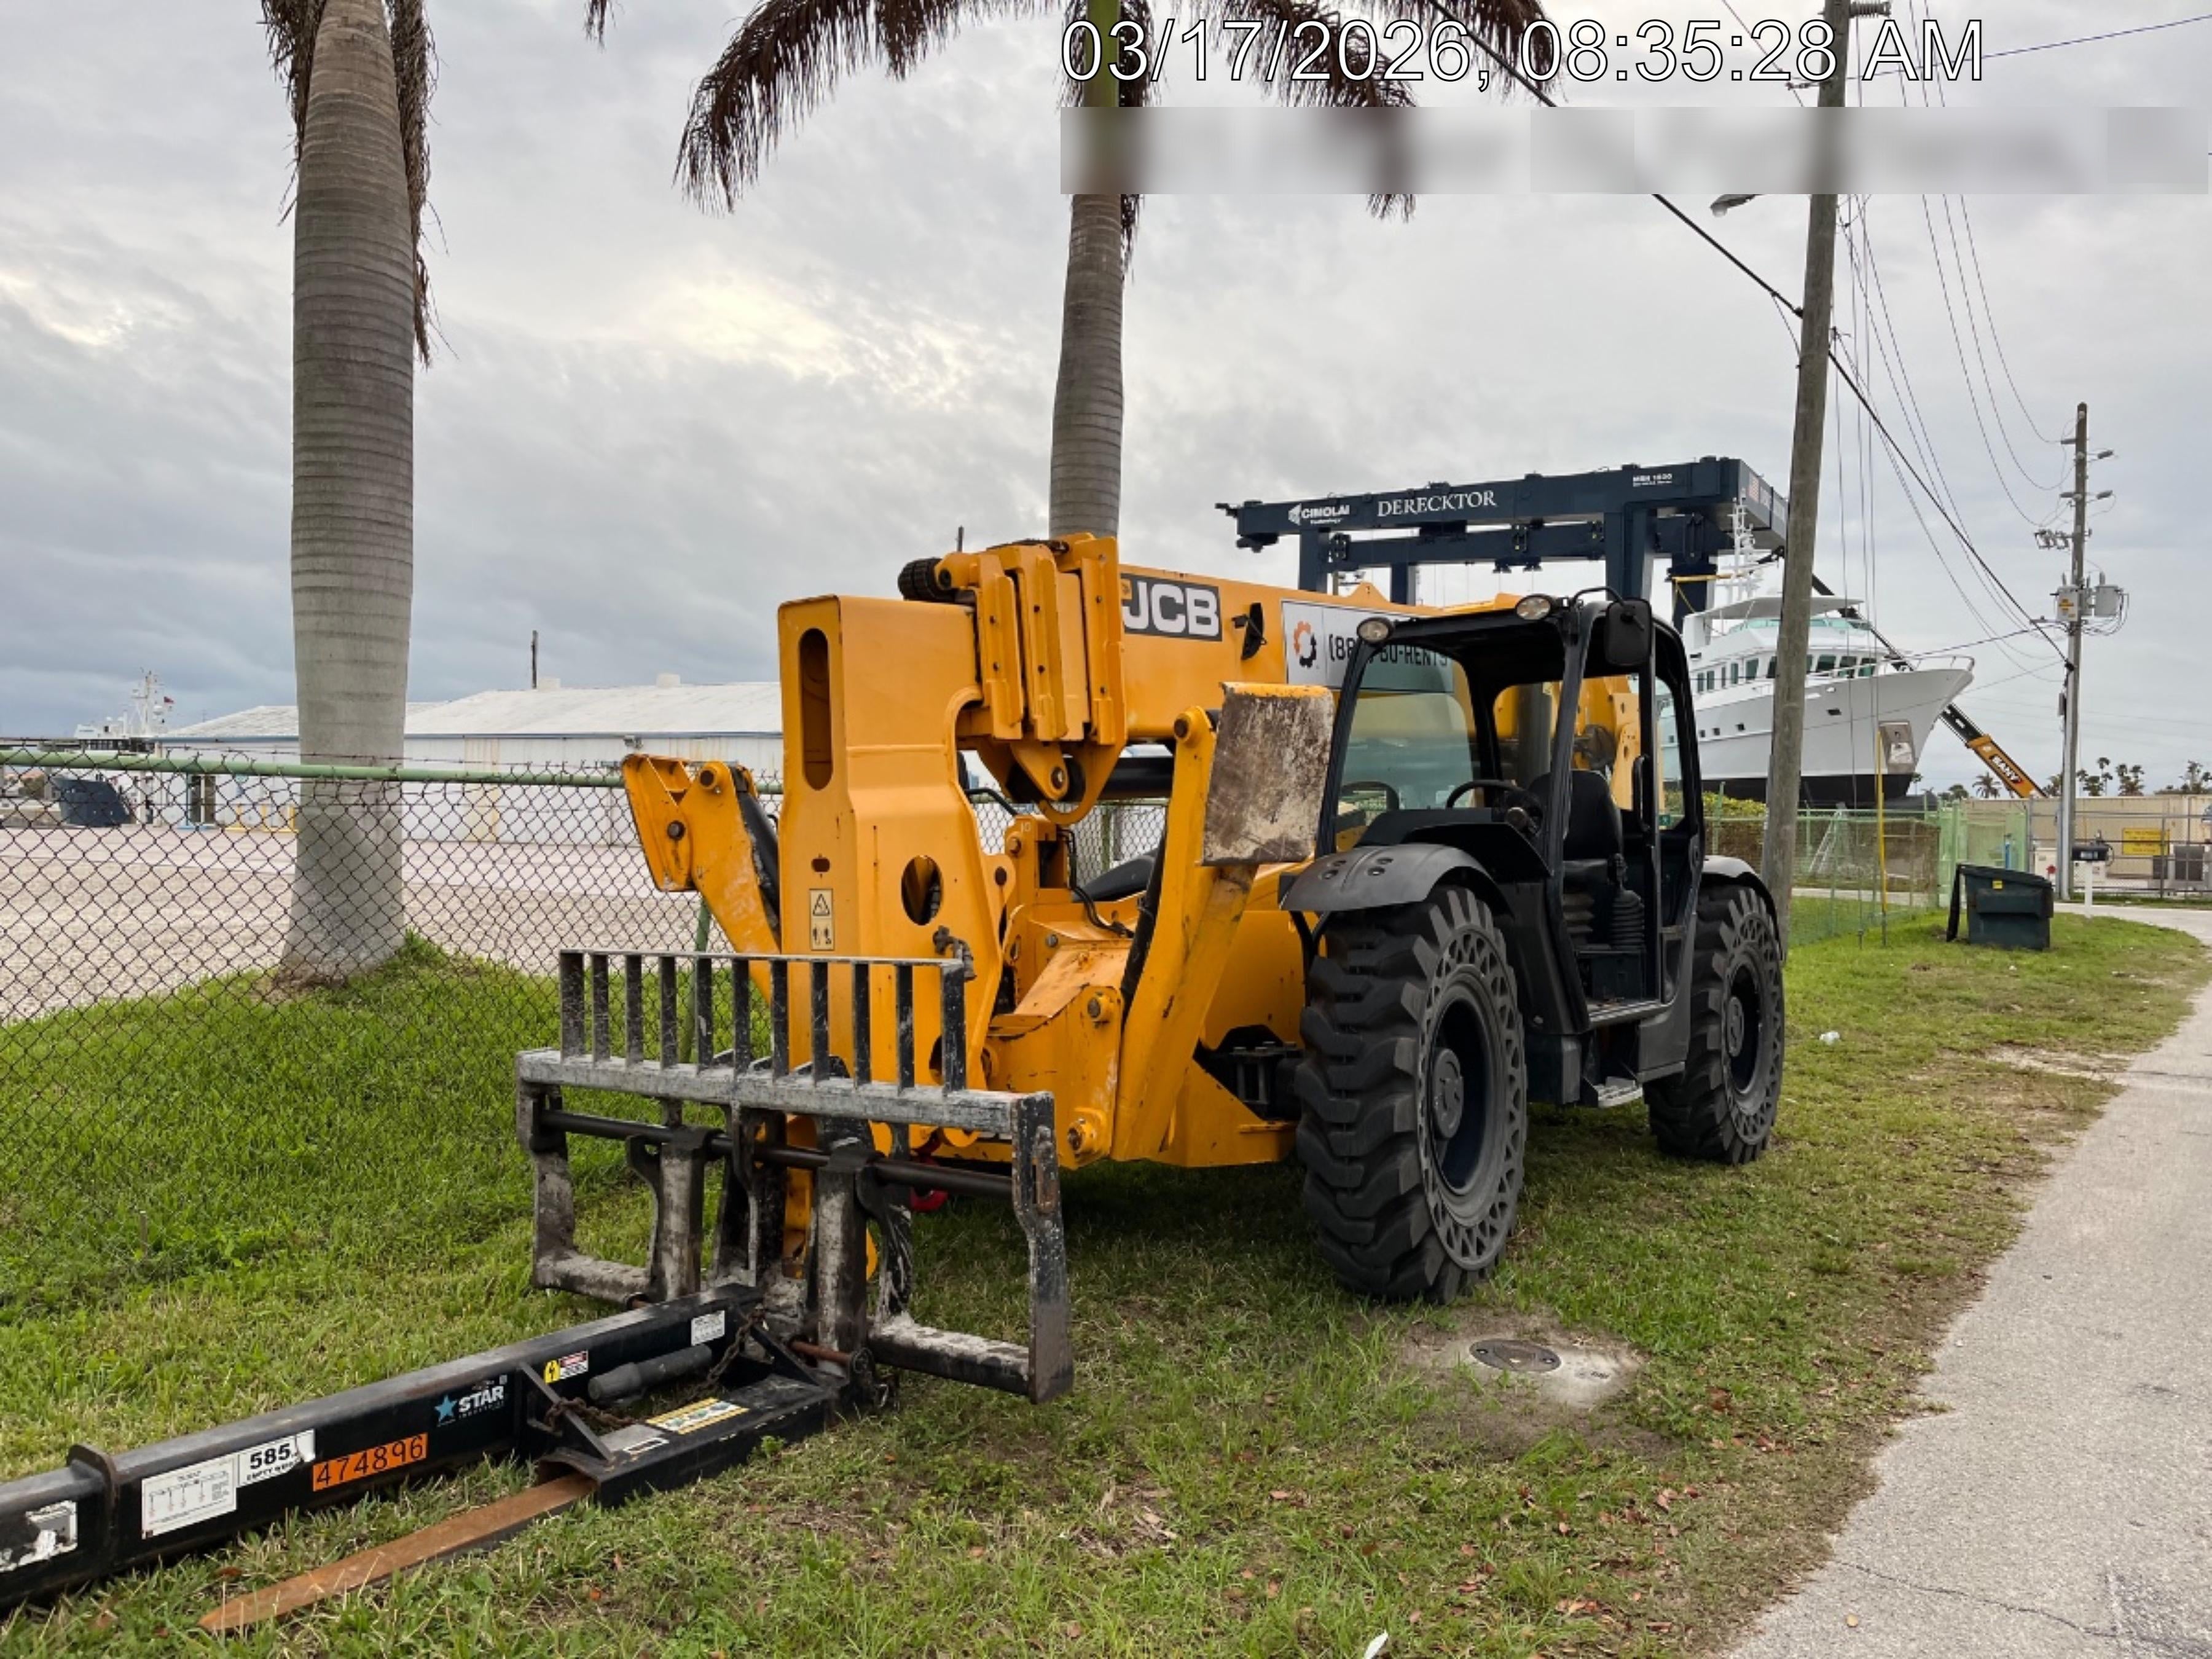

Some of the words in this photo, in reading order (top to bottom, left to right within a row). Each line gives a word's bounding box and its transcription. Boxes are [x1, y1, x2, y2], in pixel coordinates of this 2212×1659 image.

[1301, 504, 1351, 519] CIMOLAI
[1377, 490, 1498, 517] DERECKTOR
[1121, 581, 1219, 636] JCB
[1991, 755, 2020, 782] SANY
[458, 1386, 504, 1413] STAR
[250, 1442, 291, 1469] 585
[316, 1435, 423, 1485] 474896
